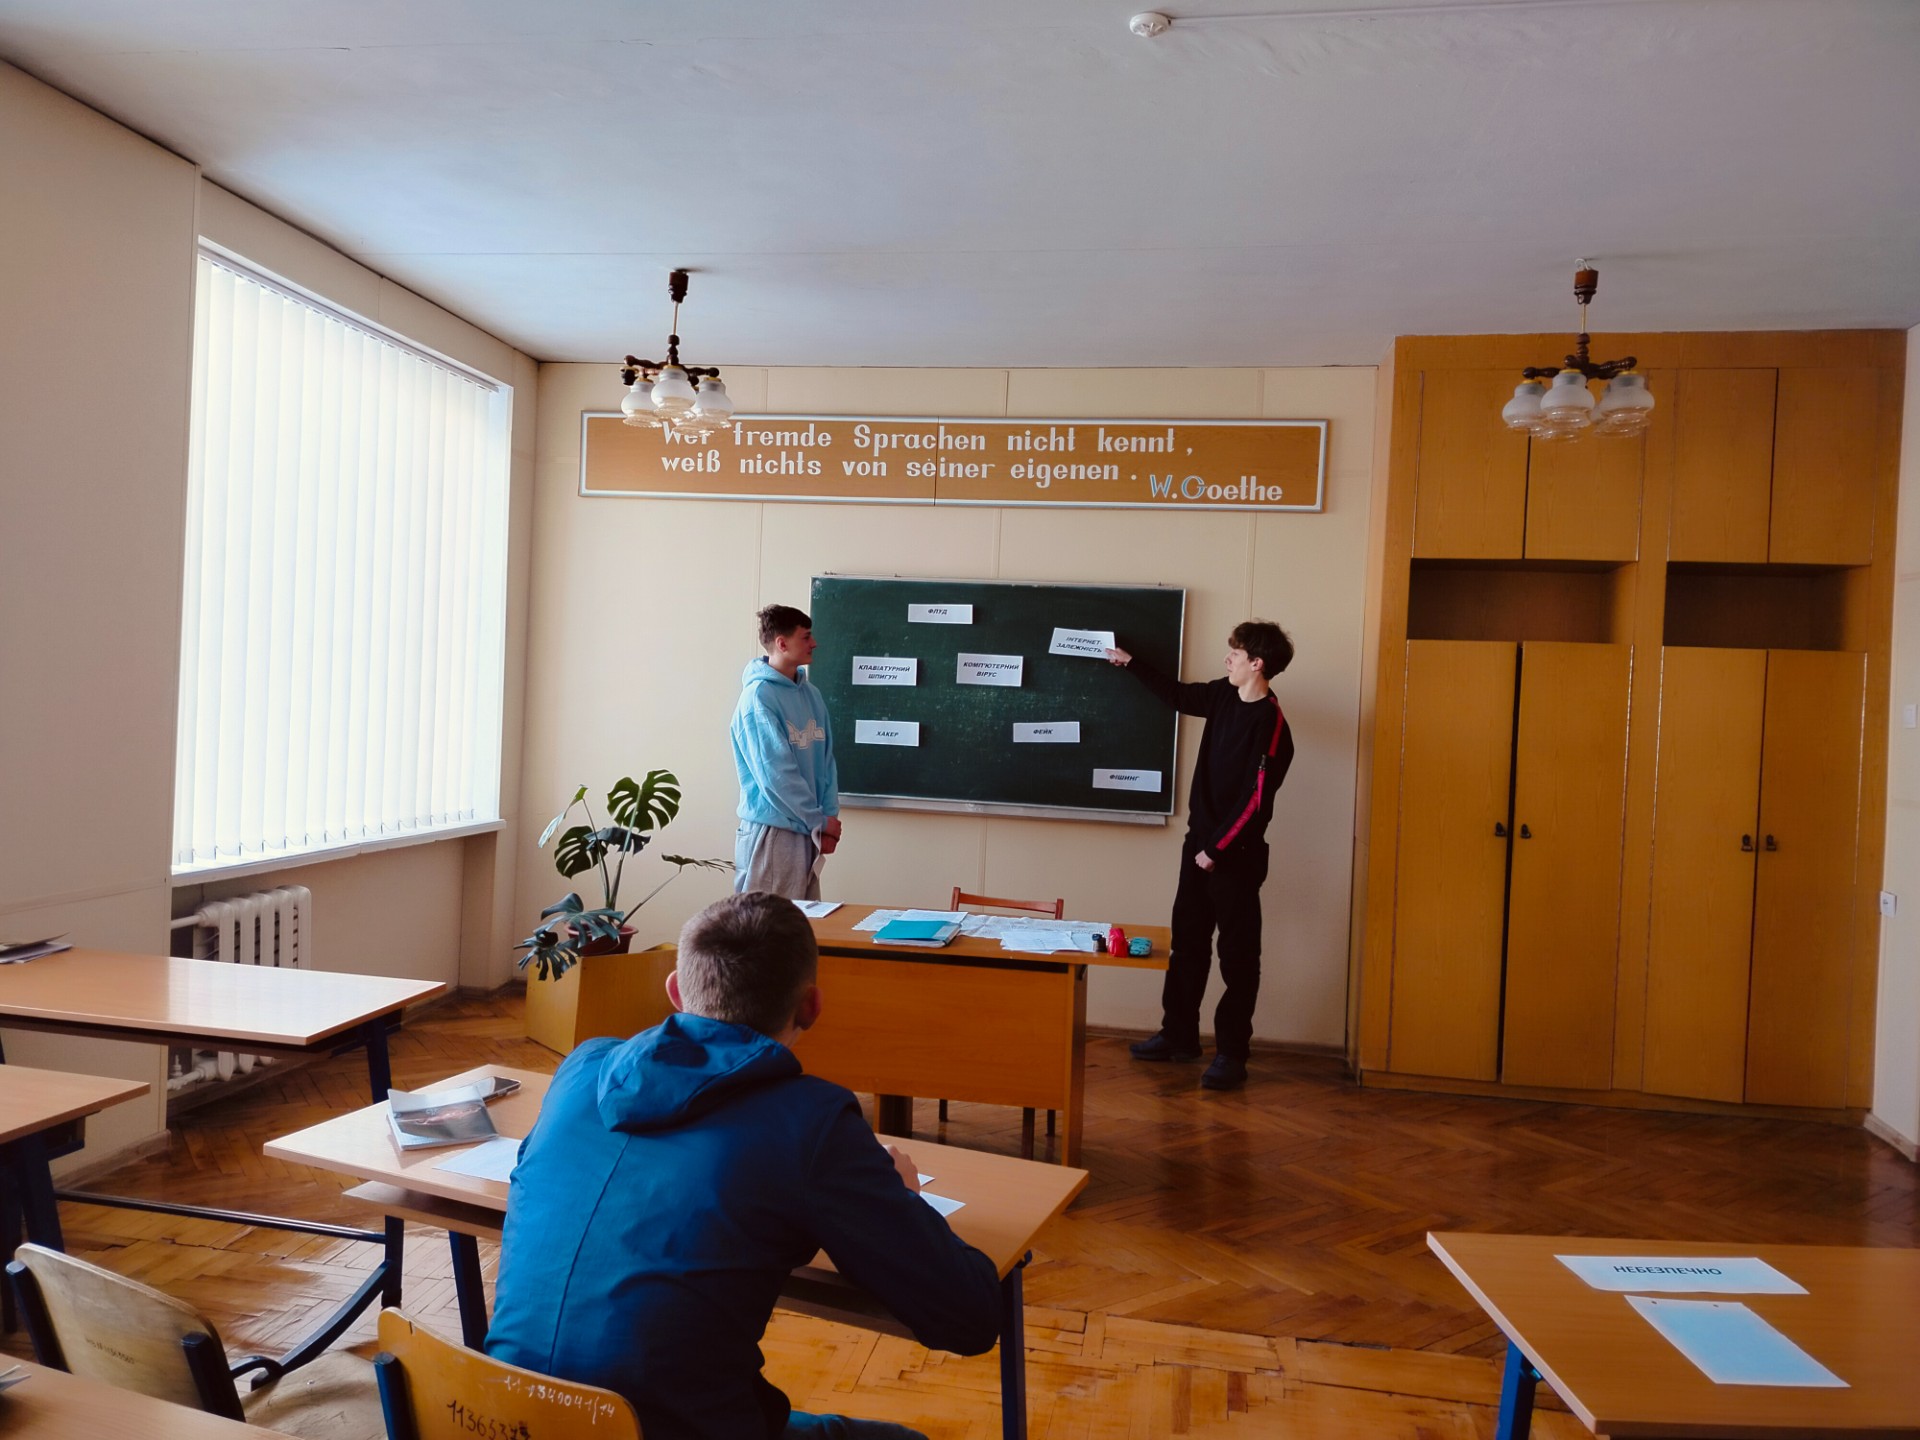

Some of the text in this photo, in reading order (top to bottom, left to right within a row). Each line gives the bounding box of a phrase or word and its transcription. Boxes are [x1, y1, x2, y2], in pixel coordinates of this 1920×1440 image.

[733, 421, 832, 447] fremde
[853, 424, 986, 457] Sprachen
[1007, 427, 1076, 452] nicht
[661, 449, 721, 473] weiß
[740, 451, 822, 476] nichts
[842, 461, 888, 476] von
[906, 457, 996, 479] seiner
[858, 664, 911, 673] КЛАВІАТУРНИЙ
[867, 673, 898, 681] ШПИГУН
[976, 670, 998, 678] ВІРУС
[1109, 774, 1140, 782] ФІШИНГ
[1613, 1265, 1722, 1276] НЕБЕЗПЕЧНО
